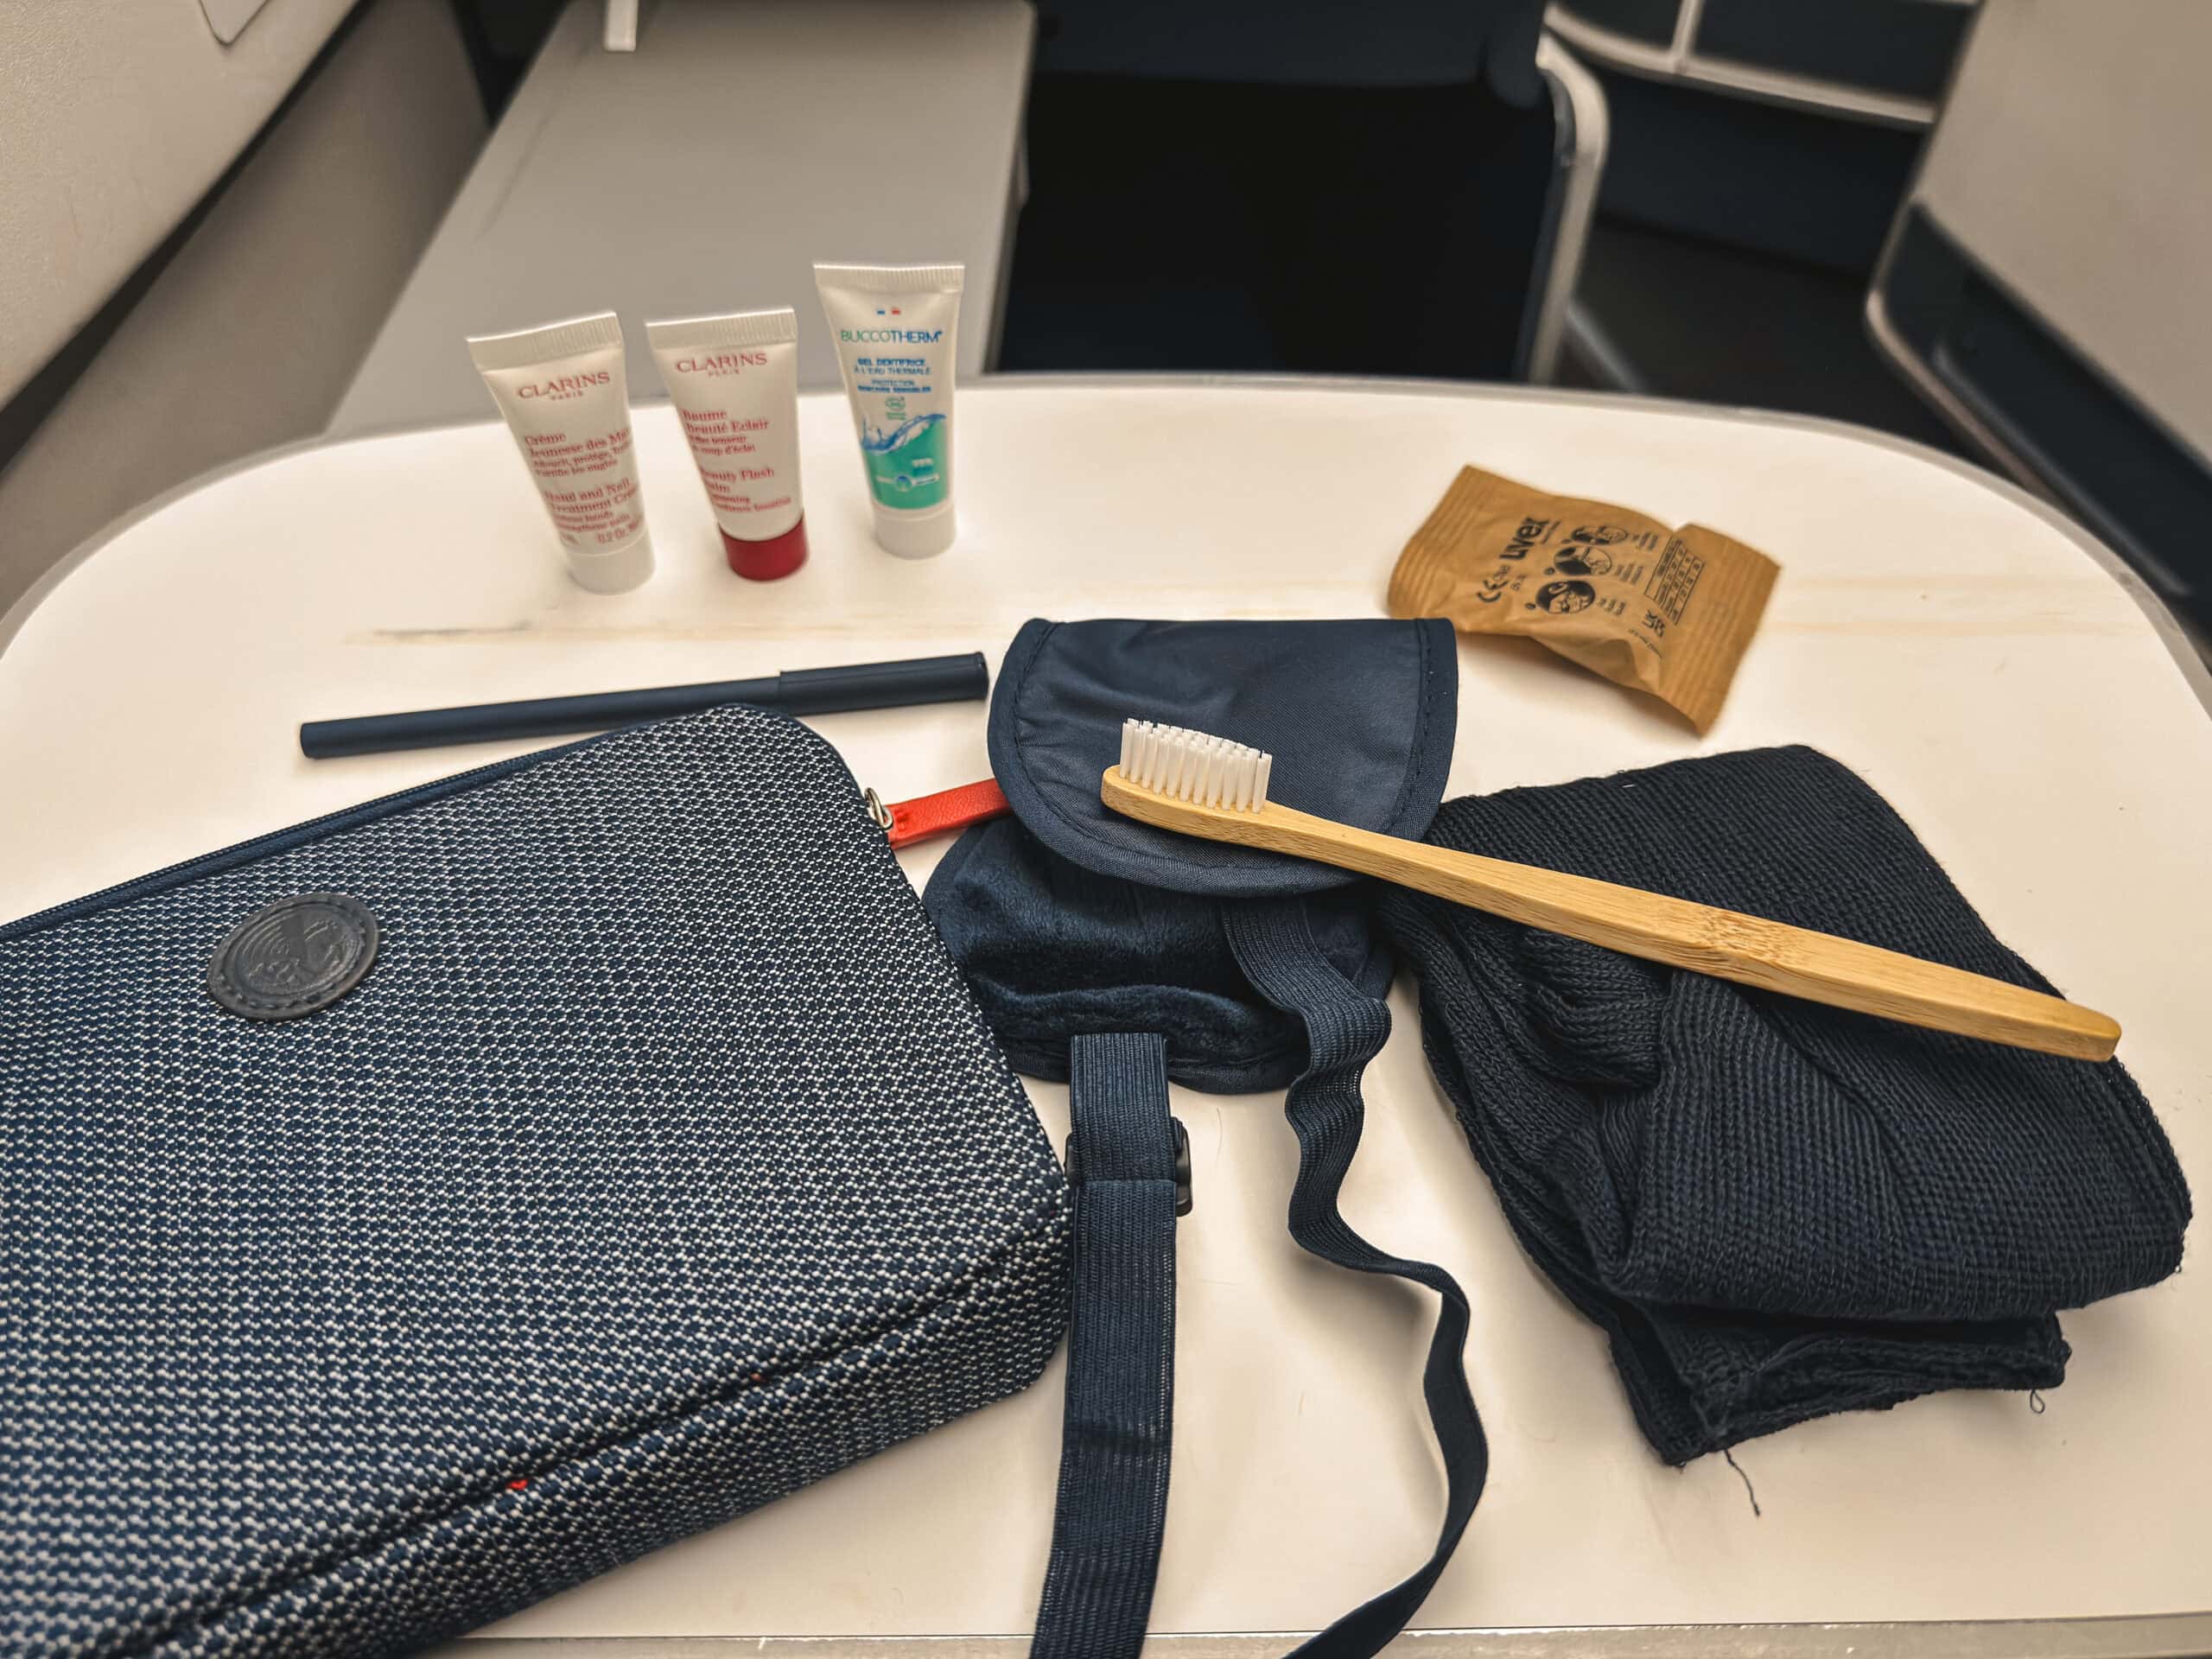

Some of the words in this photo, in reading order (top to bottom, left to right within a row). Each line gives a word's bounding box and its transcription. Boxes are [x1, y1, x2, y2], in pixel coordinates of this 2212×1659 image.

[840, 329, 940, 344] BUCCOTHERM
[676, 353, 767, 373] CLARINS
[518, 372, 611, 399] CLARINS
[585, 438, 608, 450] des
[579, 486, 604, 500] and
[1497, 516, 1551, 561] uvex
